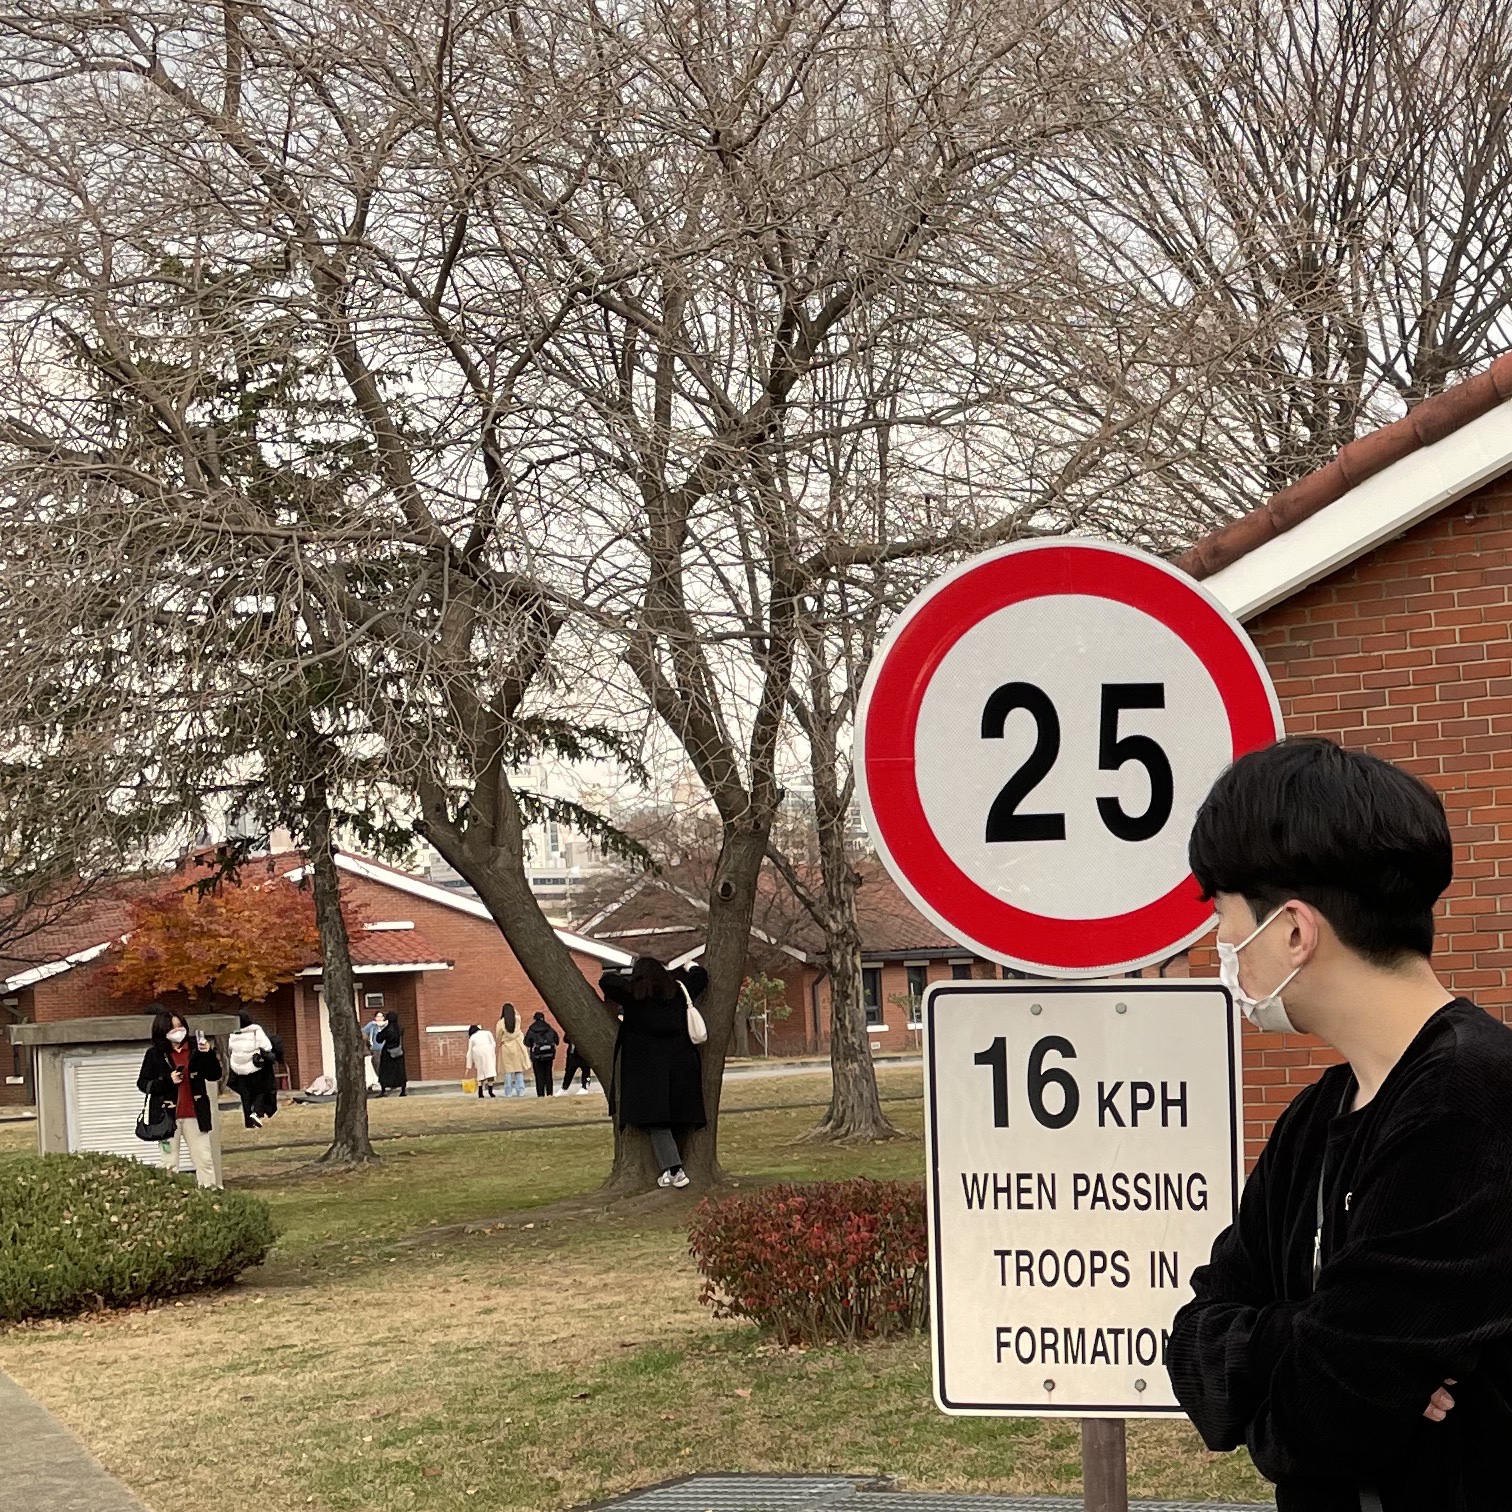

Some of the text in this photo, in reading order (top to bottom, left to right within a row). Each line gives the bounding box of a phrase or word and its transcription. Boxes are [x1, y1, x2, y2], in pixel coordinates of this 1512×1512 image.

[981, 681, 1174, 843] 25
[973, 1035, 1188, 1130] 16 KPH
[961, 1171, 1208, 1211] WHEN PASSING
[993, 1249, 1179, 1288] TROOPS IN
